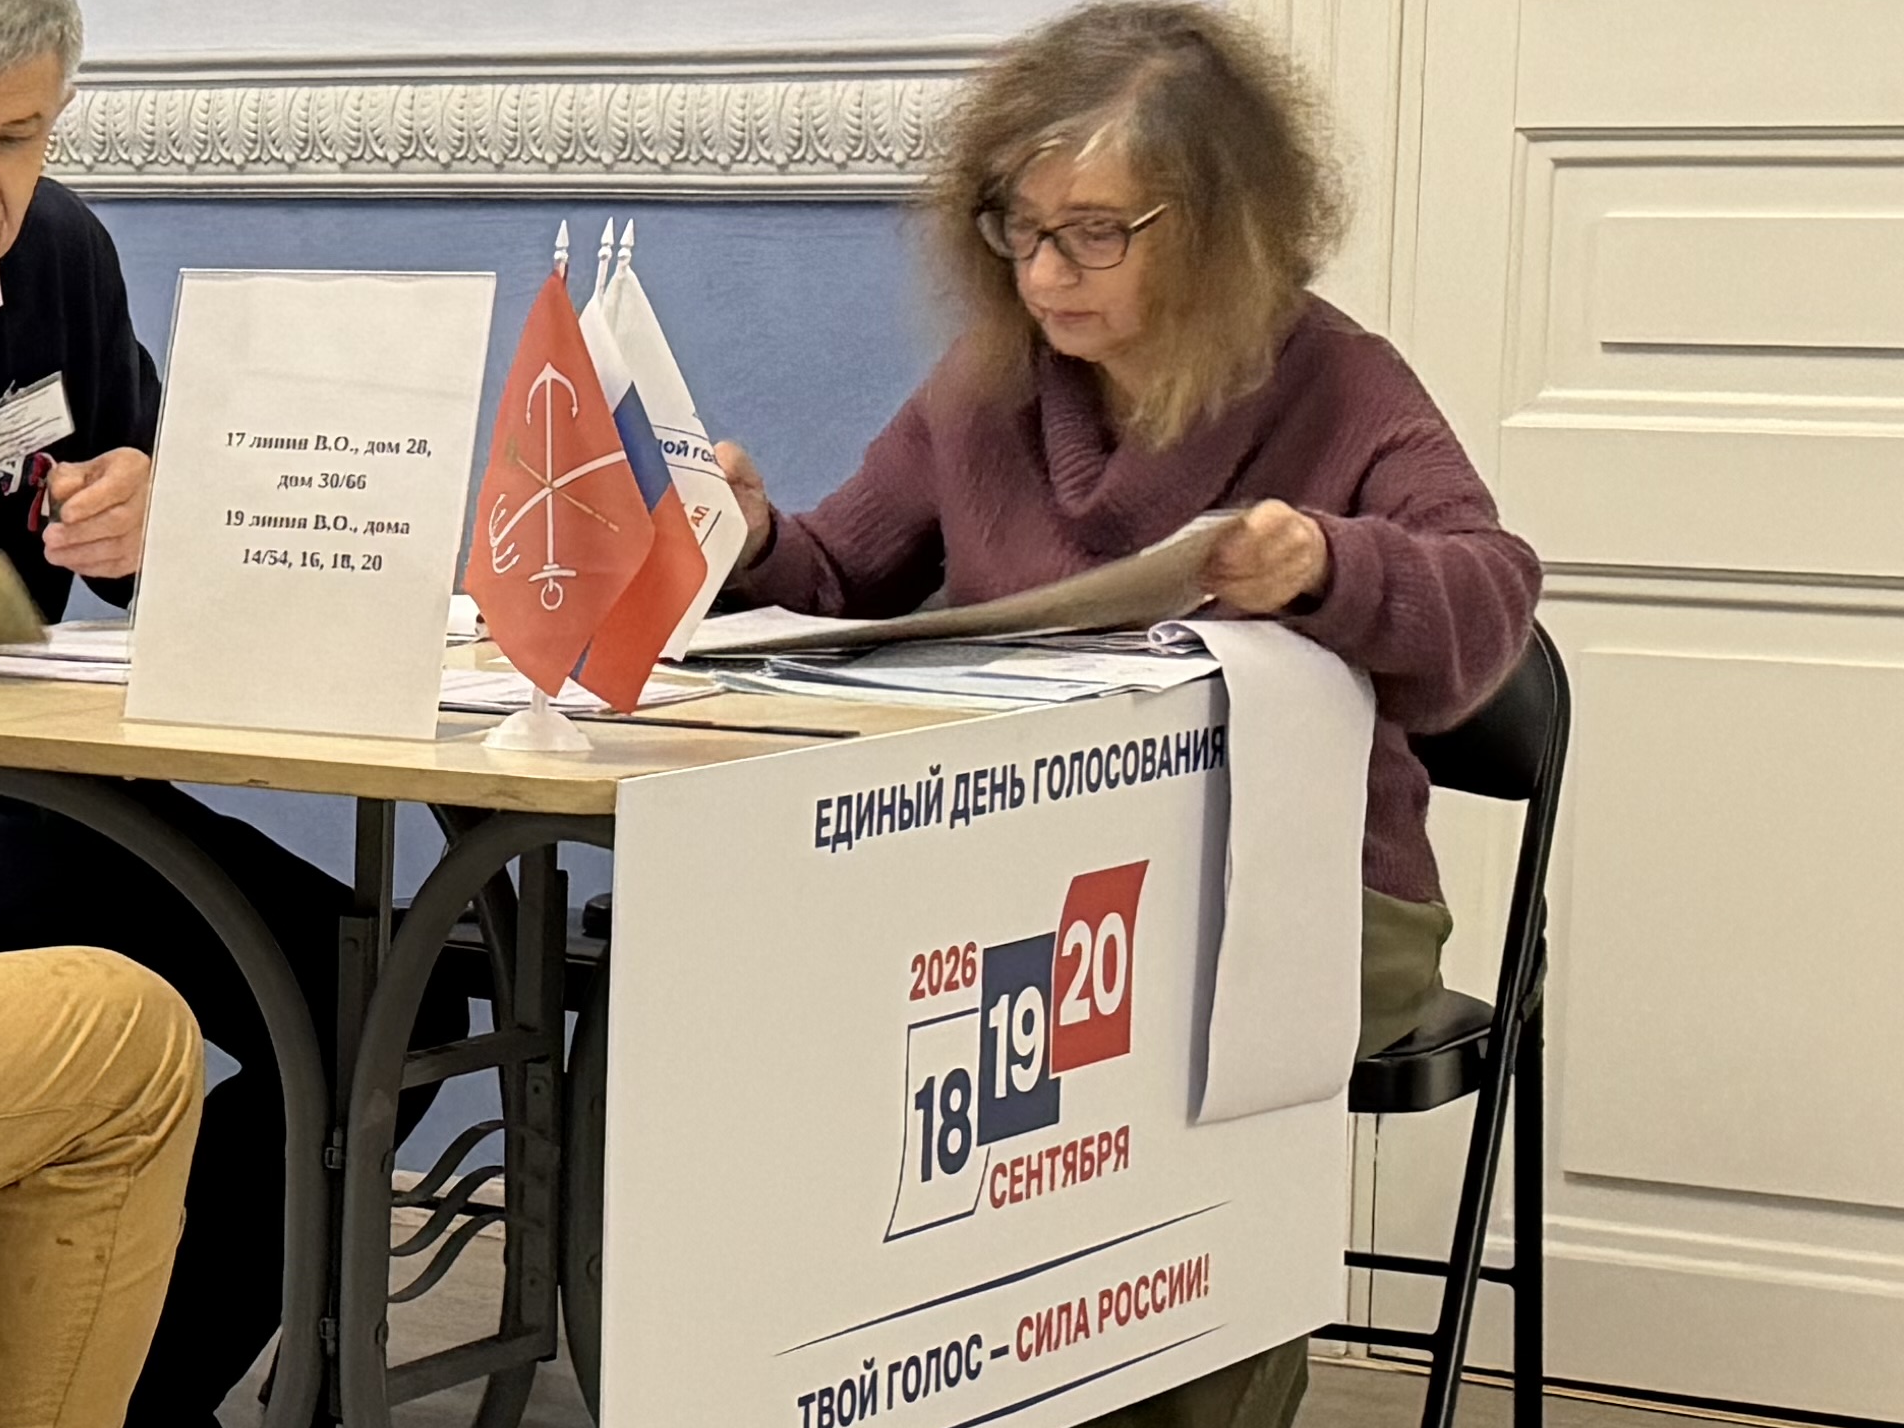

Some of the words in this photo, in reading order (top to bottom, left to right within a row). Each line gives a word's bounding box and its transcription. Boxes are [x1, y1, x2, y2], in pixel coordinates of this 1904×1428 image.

[224, 432, 246, 447] 17
[248, 435, 309, 451] линия
[314, 434, 360, 455] В.О.,
[363, 439, 400, 456] дом
[405, 438, 432, 457] 28,
[659, 439, 689, 457] ОЙ
[277, 474, 313, 490] дом
[318, 472, 367, 490] 30/66
[224, 509, 245, 526] 19
[248, 513, 308, 530] линия
[313, 514, 358, 534] В.О.,
[362, 519, 410, 536] дома
[242, 548, 293, 569] 14/54,
[300, 551, 325, 570] 16,
[331, 552, 355, 572] 18,
[360, 553, 383, 572] 20
[814, 764, 945, 853] ЕДИНЫЙ
[949, 763, 1025, 829] ДЕНЬ
[1032, 724, 1226, 805] ГОЛОСОВАНИЯ
[909, 941, 977, 1001] 2026
[914, 1067, 972, 1183] 18
[989, 985, 1045, 1099] 19
[1059, 912, 1128, 1026] 20
[989, 1125, 1130, 1210] СЕНТЯБРЯ
[887, 1333, 983, 1410] ГОЛОС
[1016, 1297, 1091, 1362] СИЛА
[1098, 1252, 1210, 1334] РОССИИ!
